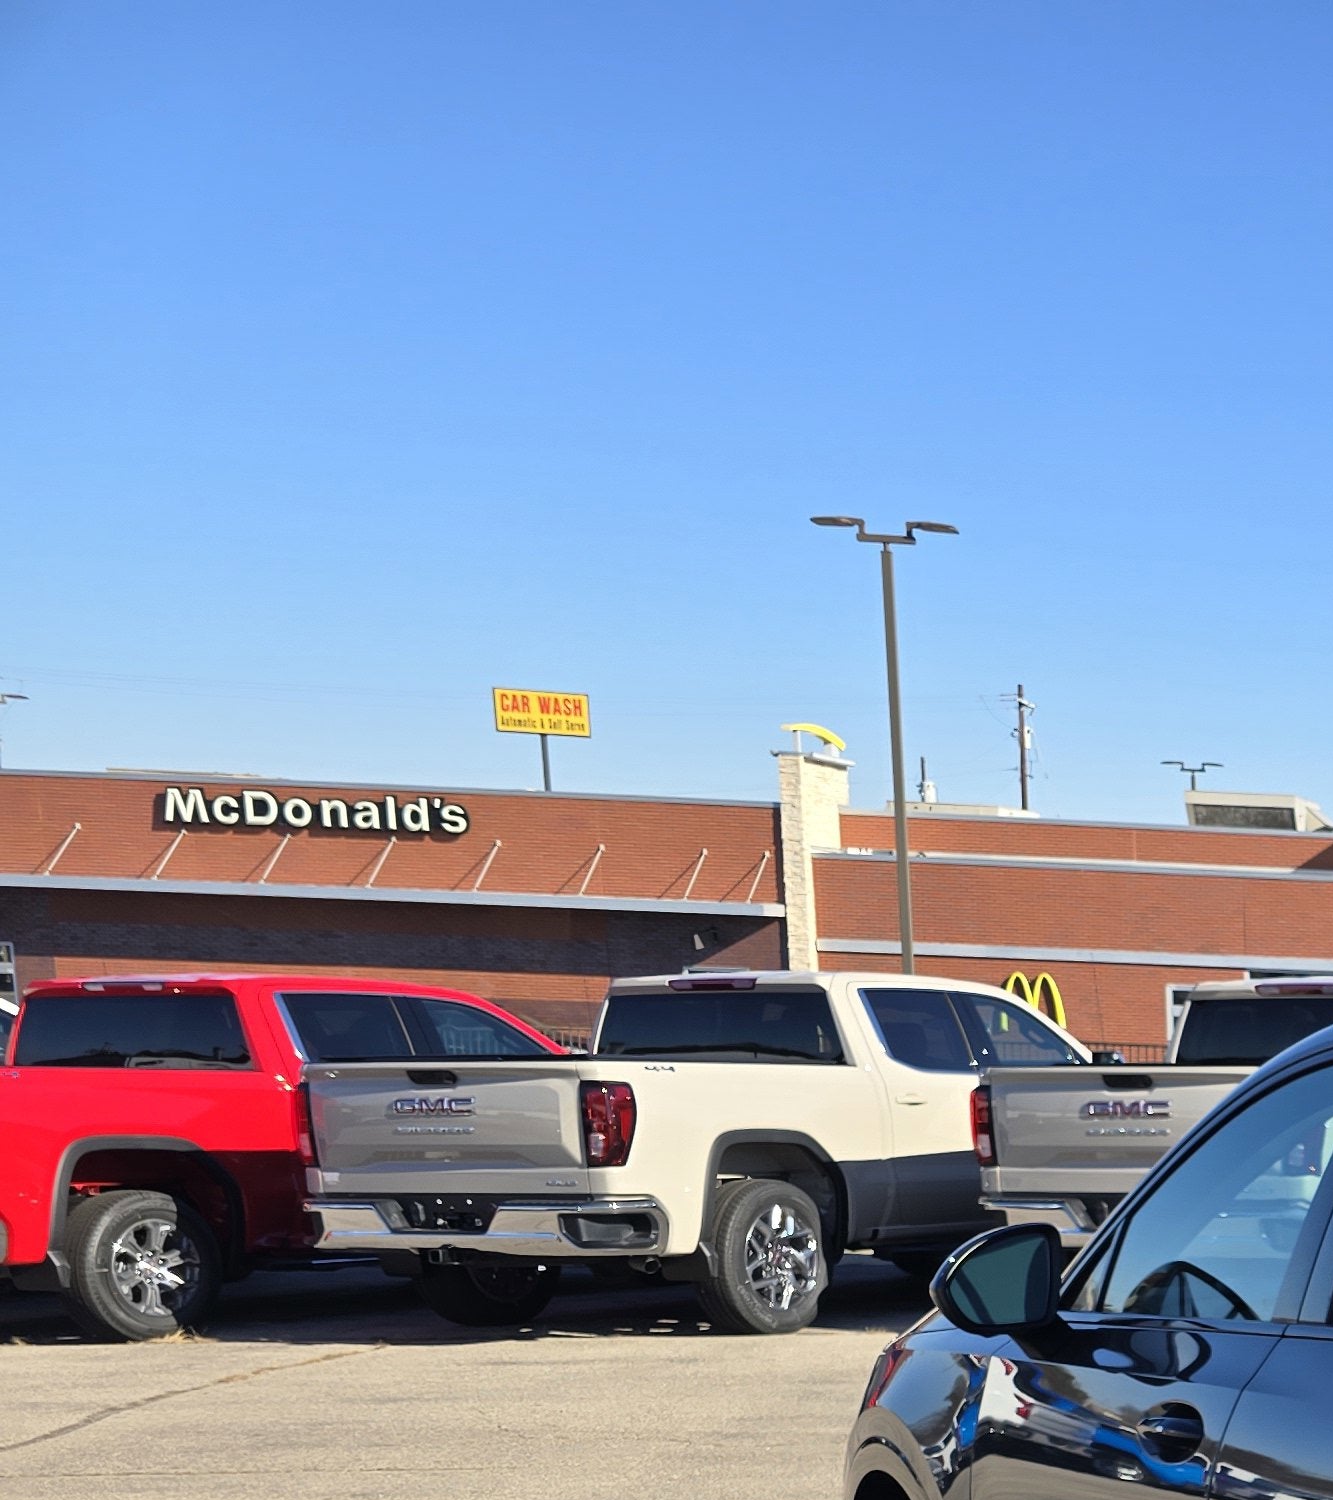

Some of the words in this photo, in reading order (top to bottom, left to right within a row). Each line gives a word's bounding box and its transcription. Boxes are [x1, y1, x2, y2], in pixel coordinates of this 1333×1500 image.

[500, 693, 530, 713] CAR
[538, 695, 582, 717] WASH
[501, 716, 537, 729] Automatic
[163, 787, 469, 834] McDonald's
[393, 1096, 476, 1116] GMC
[1086, 1100, 1173, 1119] GMC
